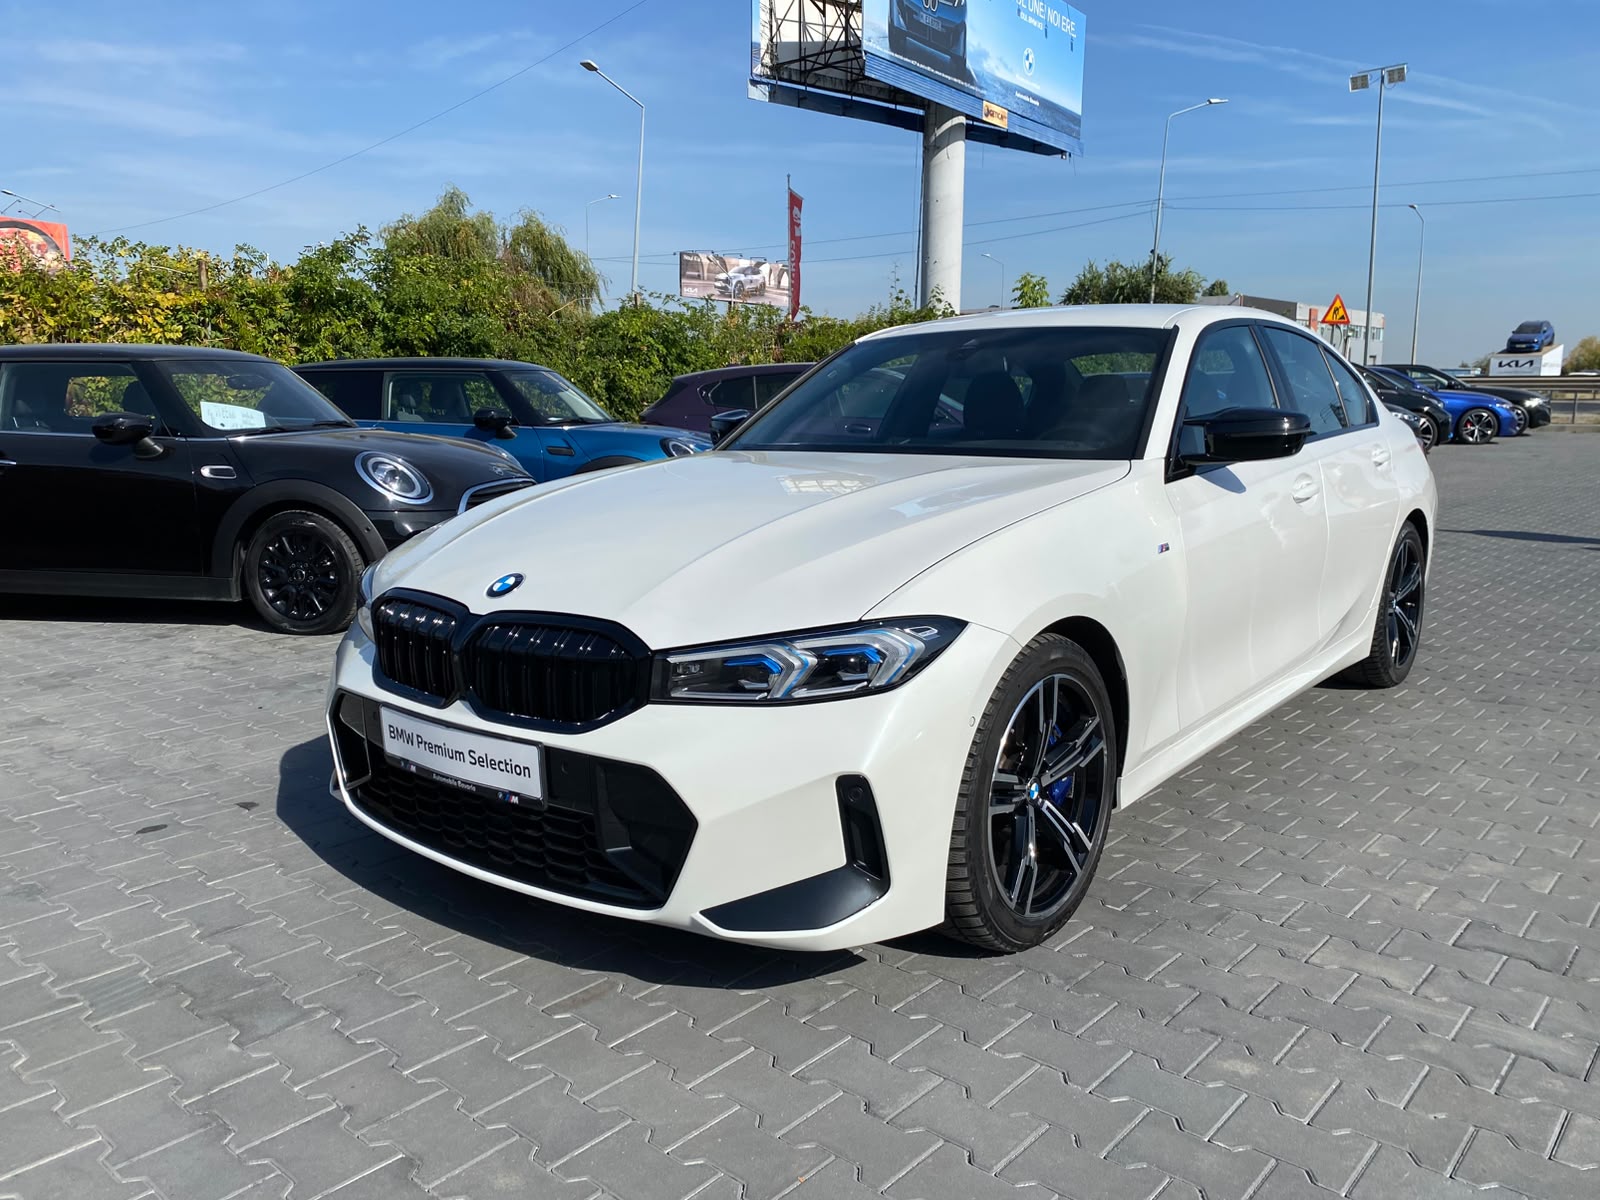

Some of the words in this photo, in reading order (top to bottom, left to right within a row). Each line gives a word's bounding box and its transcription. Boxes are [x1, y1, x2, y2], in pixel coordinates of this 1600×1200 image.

[1048, 7, 1061, 28] NOI
[1498, 360, 1535, 368] KIA
[388, 724, 414, 747] BMW
[416, 734, 466, 763] Premium
[469, 749, 531, 779] Selection
